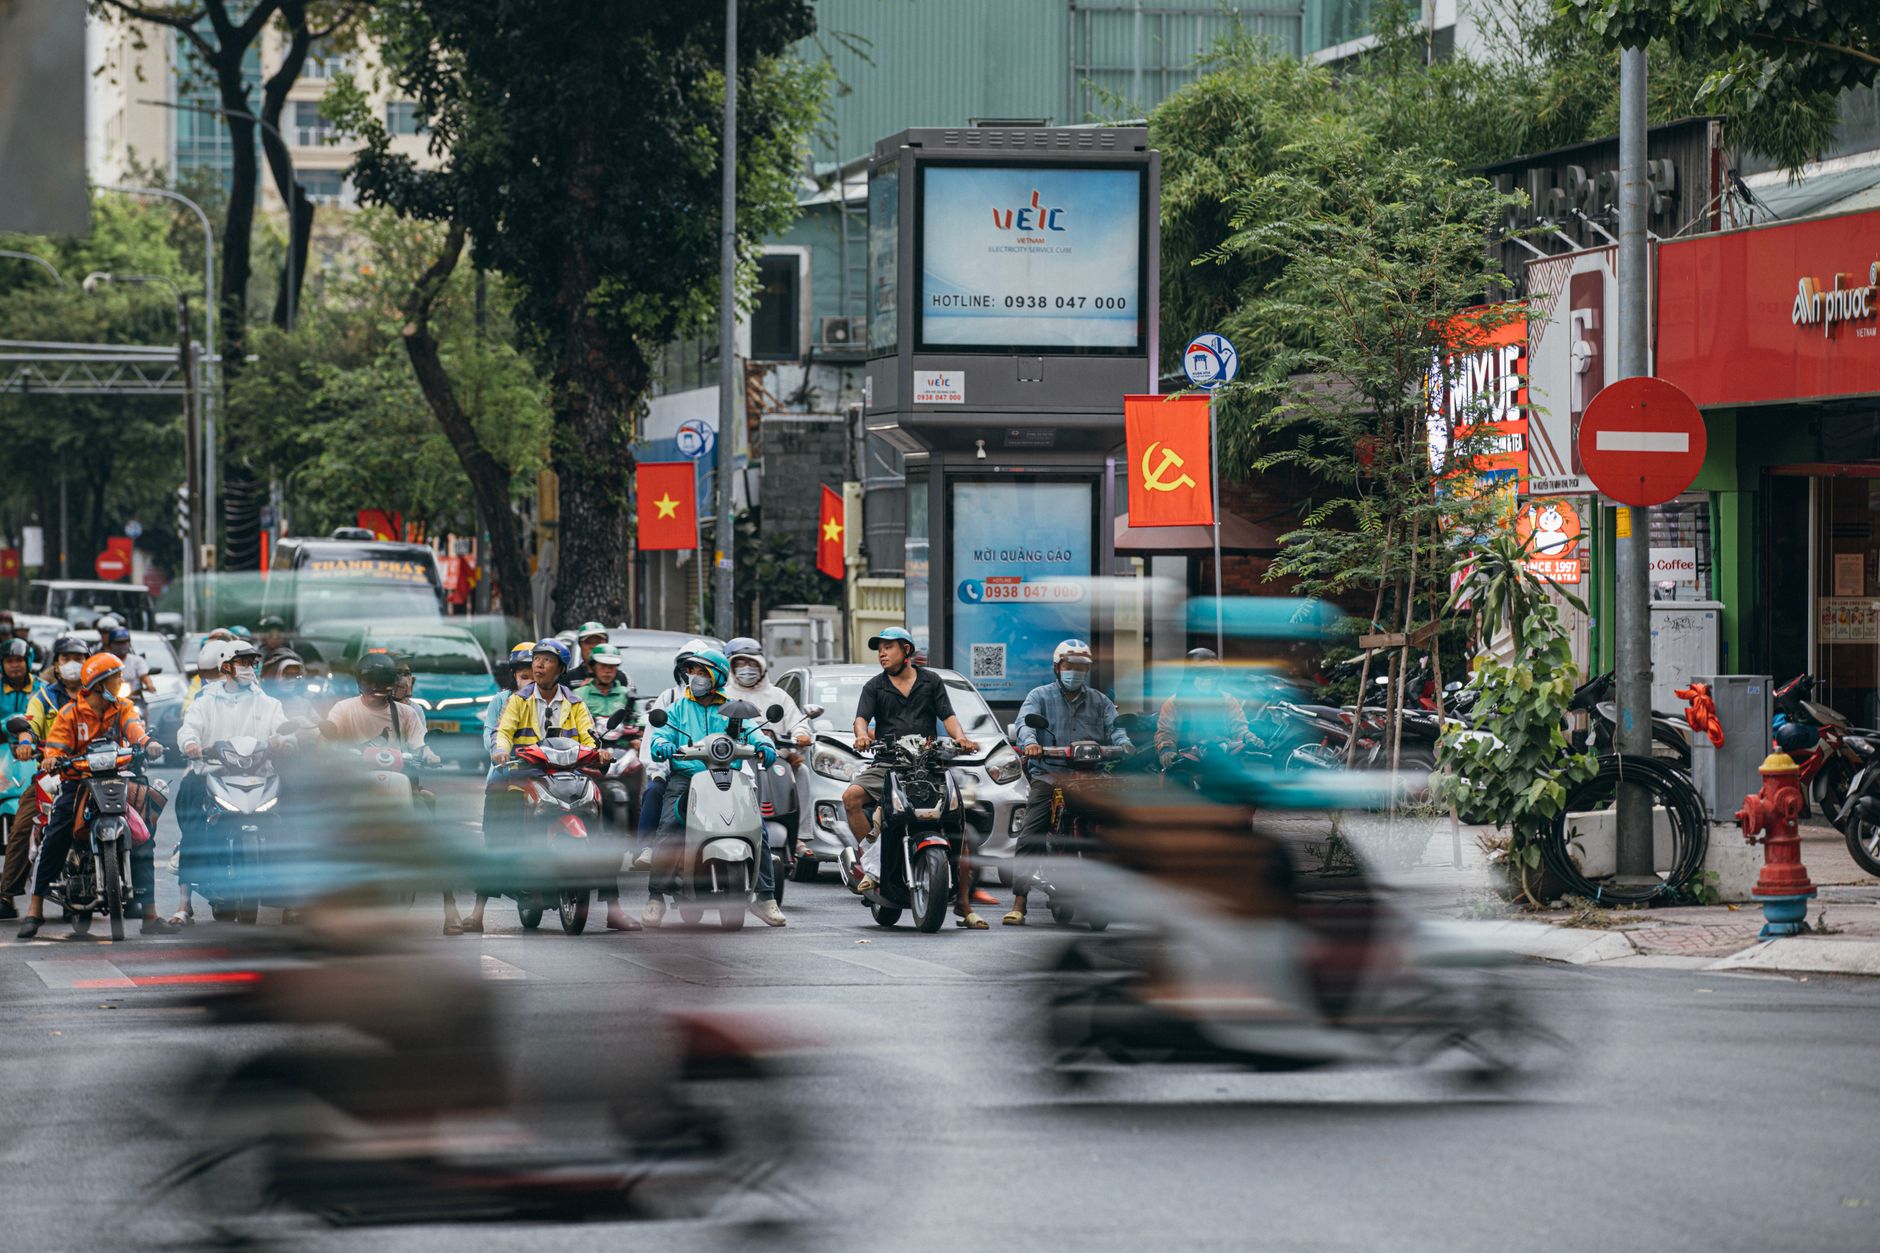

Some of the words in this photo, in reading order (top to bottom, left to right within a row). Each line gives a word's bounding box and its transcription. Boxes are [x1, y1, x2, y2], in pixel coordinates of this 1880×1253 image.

[932, 295, 995, 308] HOTLINE:
[1004, 296, 1047, 308] 0938
[1055, 296, 1087, 309] 047
[1095, 297, 1126, 309] 000
[1856, 327, 1877, 337] VIETNAM
[974, 547, 995, 561] MỜI
[1000, 546, 1042, 562] QUẢNG
[1046, 546, 1072, 561] CÁO
[1555, 561, 1577, 573] 1997
[1657, 559, 1694, 570] Coffee
[985, 586, 1018, 598] 0938
[1024, 586, 1048, 598] 047
[1054, 586, 1078, 598] 000
